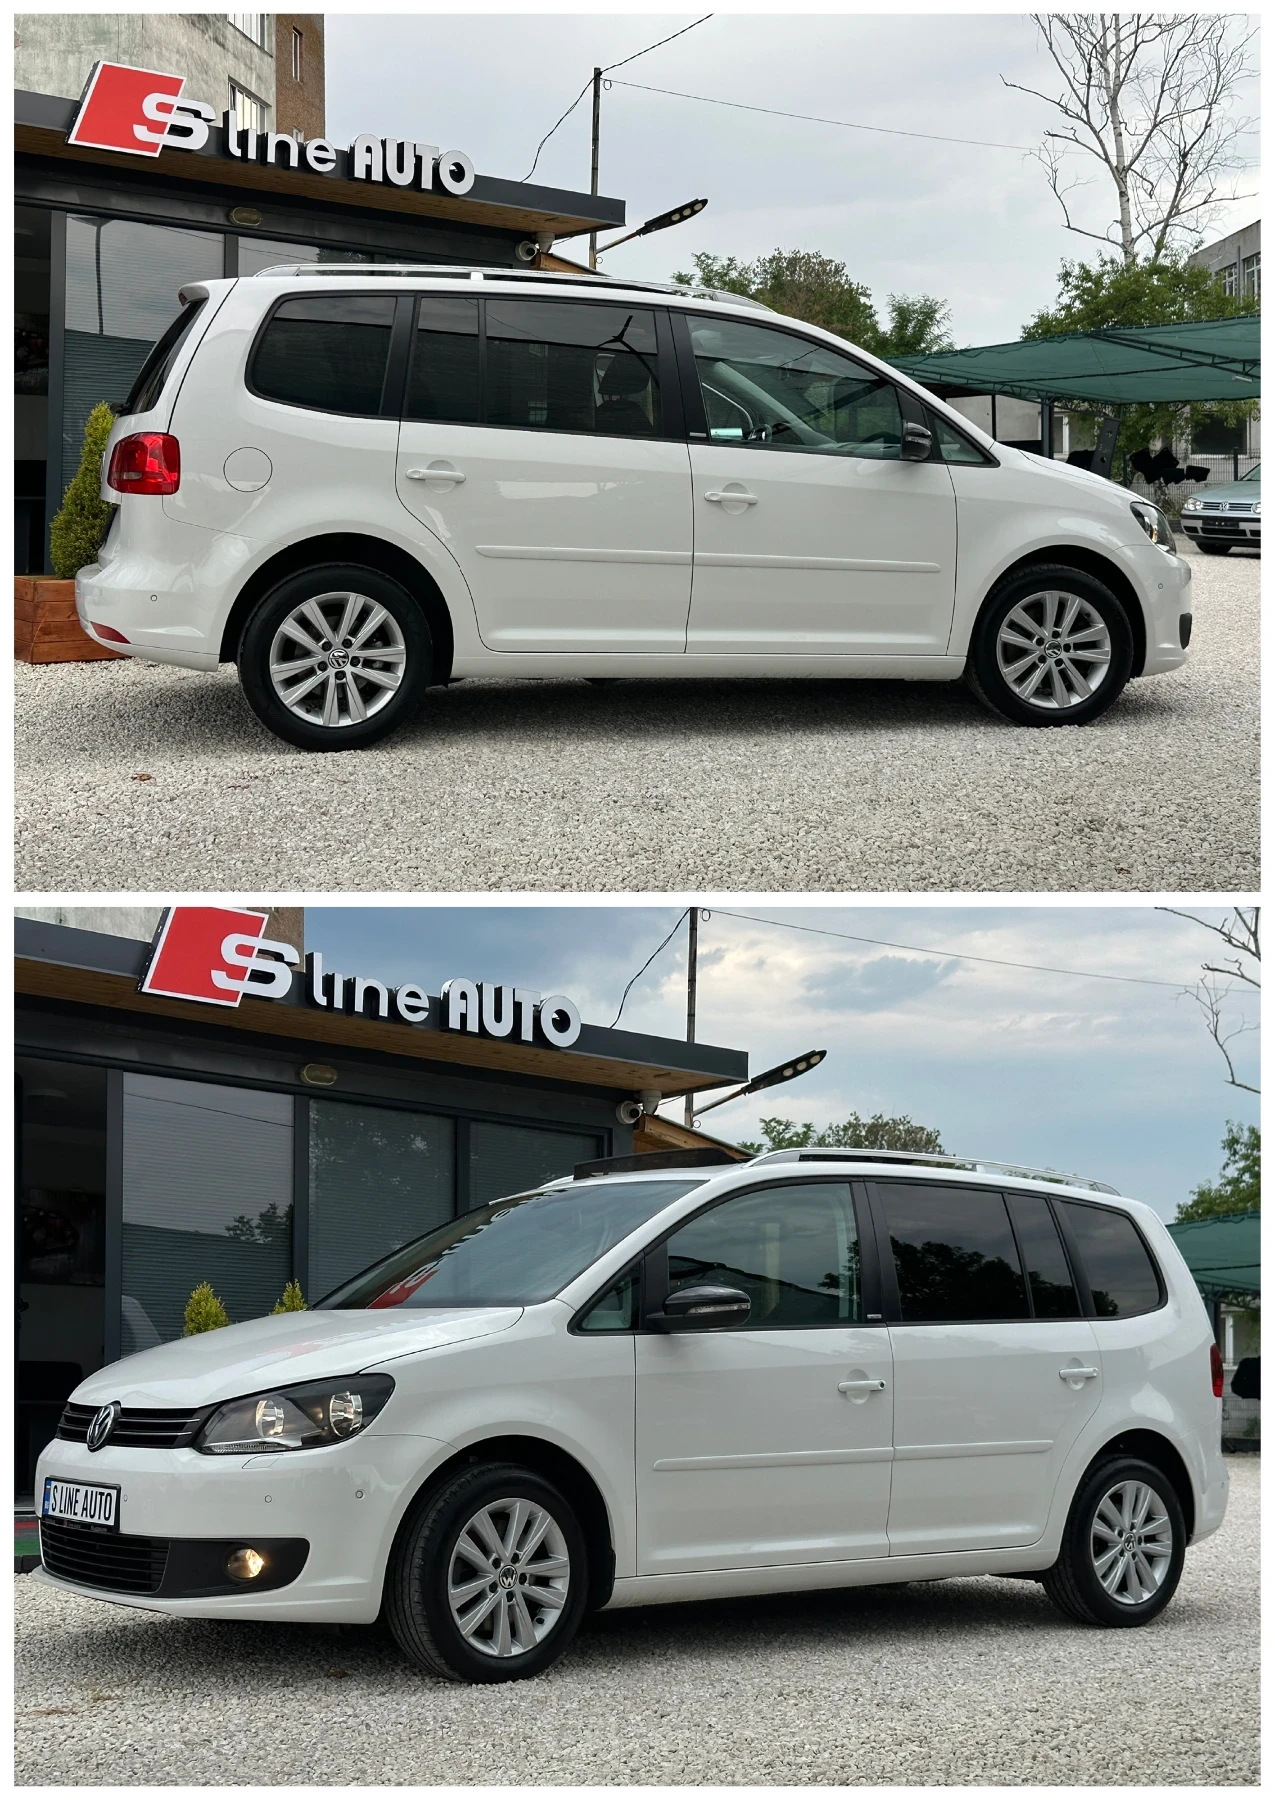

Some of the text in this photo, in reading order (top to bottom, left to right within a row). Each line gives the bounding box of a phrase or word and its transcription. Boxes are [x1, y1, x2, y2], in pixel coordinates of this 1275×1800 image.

[132, 92, 476, 196] S line AUTO
[211, 933, 582, 1048] S line AUTO
[51, 1485, 113, 1522] S LINE AUTO
